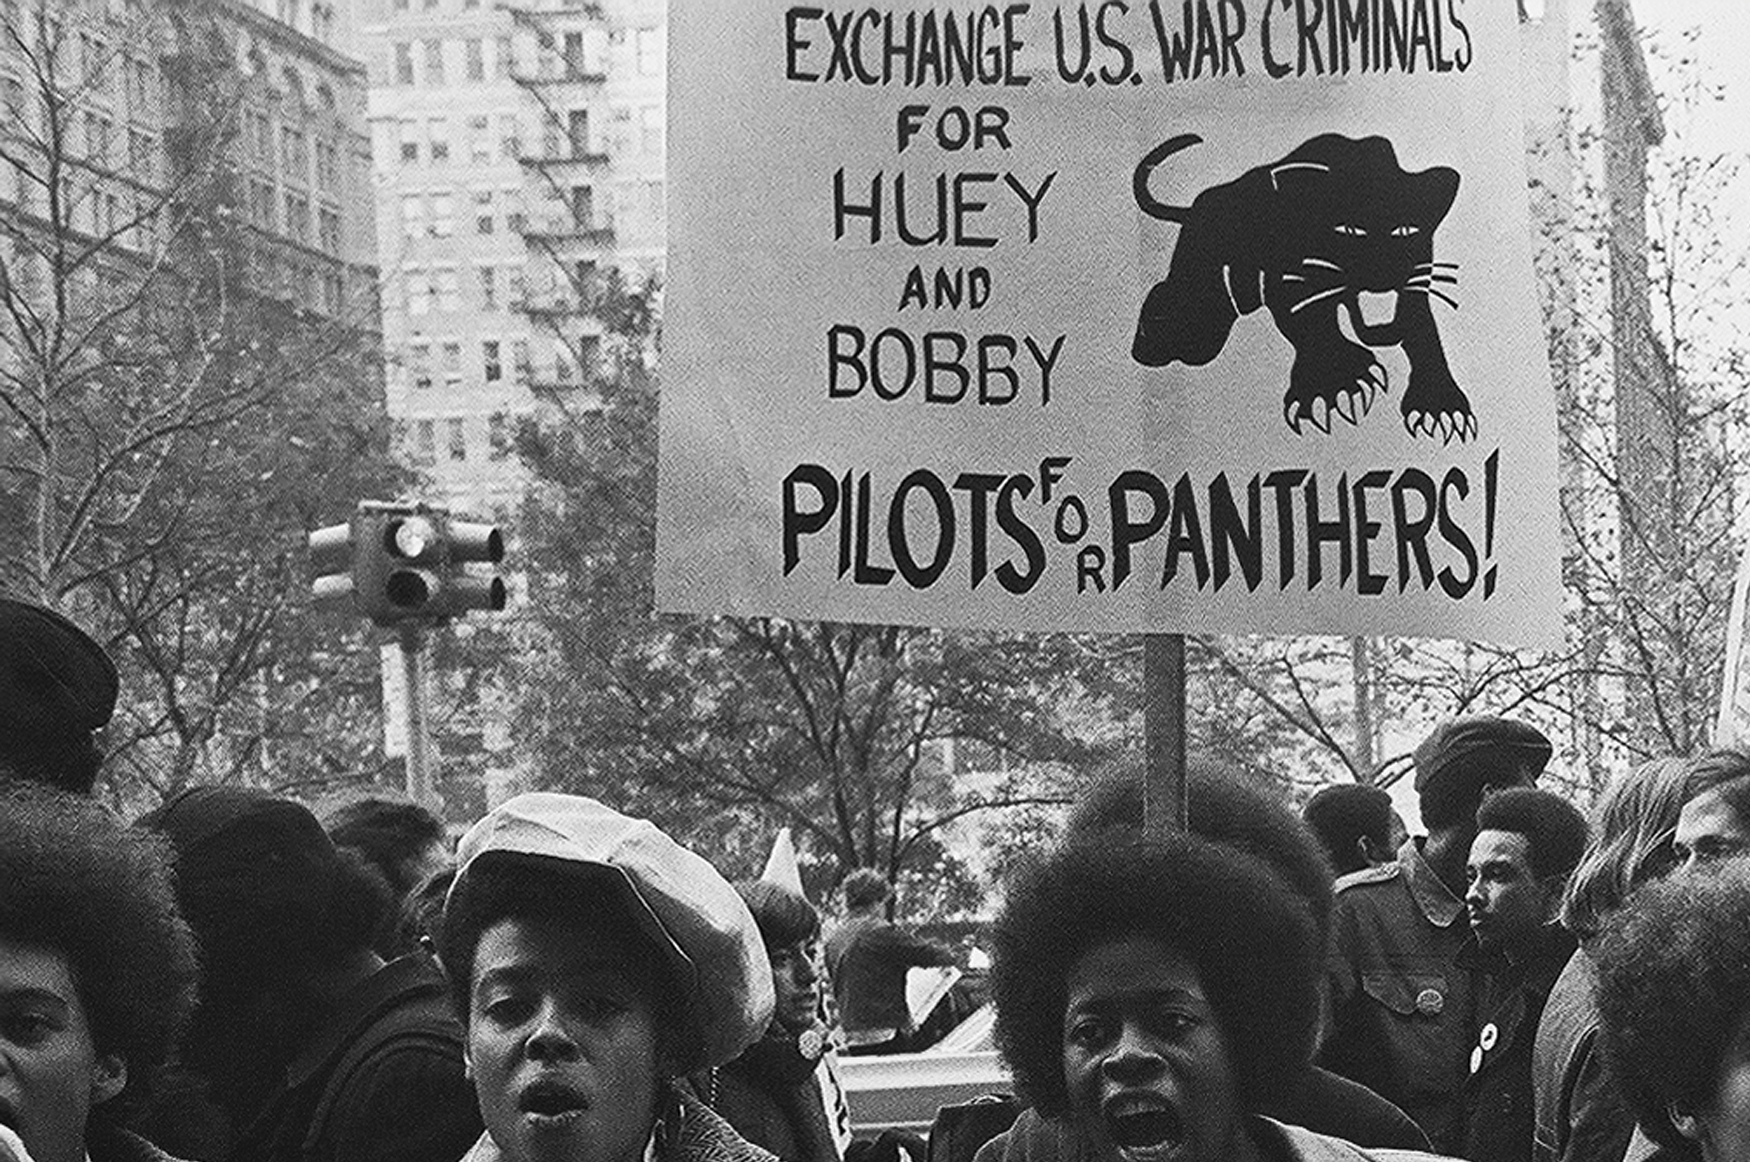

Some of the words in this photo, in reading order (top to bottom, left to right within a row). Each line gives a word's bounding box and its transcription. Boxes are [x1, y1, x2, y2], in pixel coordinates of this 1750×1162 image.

[786, 3, 1032, 87] EXCHANGE
[1054, 0, 1142, 86] U.S.
[1150, 0, 1246, 83] WAR
[1261, 0, 1471, 78] CRIMINALS
[897, 105, 1011, 152] FOR
[833, 168, 1056, 248] HUEY
[898, 264, 991, 311] AND
[827, 325, 1066, 406] BOBBY
[783, 462, 1046, 594] PILOTS
[1039, 457, 1106, 594] FOR
[1108, 449, 1500, 600] PANTHERS!
